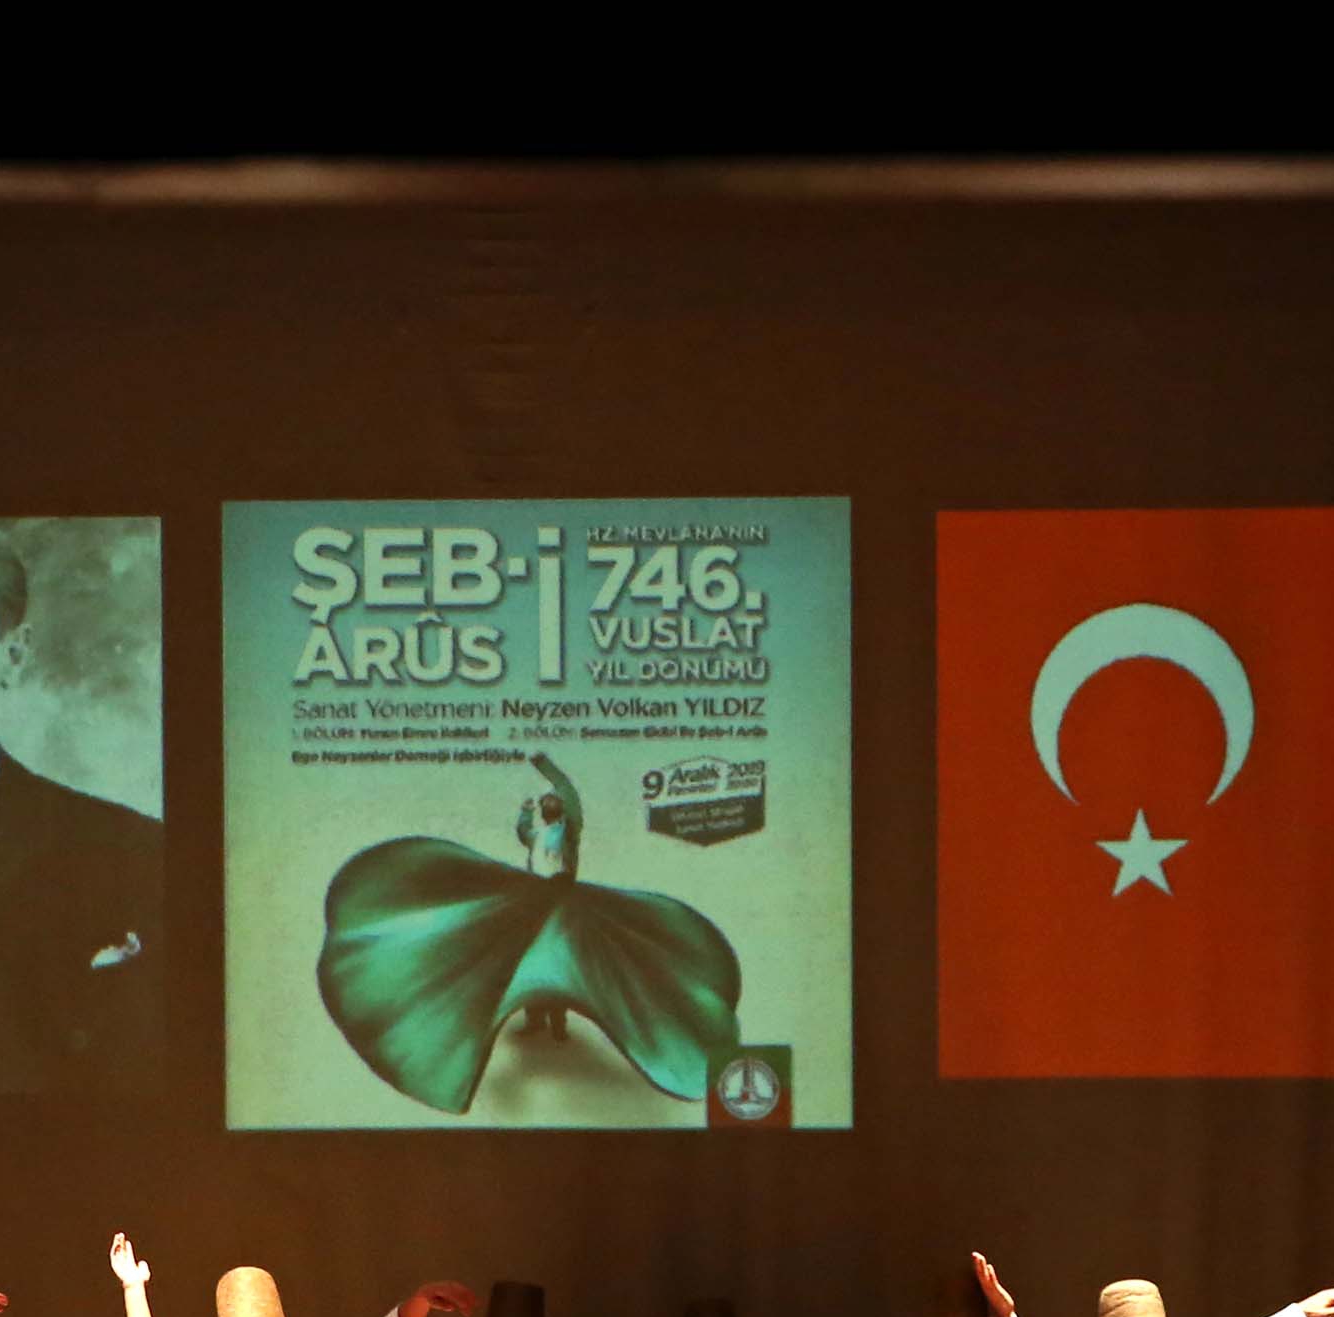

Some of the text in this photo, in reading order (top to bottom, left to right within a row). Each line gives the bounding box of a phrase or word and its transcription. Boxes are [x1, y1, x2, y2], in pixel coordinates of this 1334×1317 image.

[587, 546, 763, 613] 746.
[589, 617, 765, 650] VUSLAT
[588, 659, 630, 681] YIL
[292, 700, 358, 720] Sanat
[502, 699, 590, 721] Neyzen
[597, 699, 677, 717] Volkan
[684, 698, 765, 717] YILDIZ
[642, 770, 665, 800] 9
